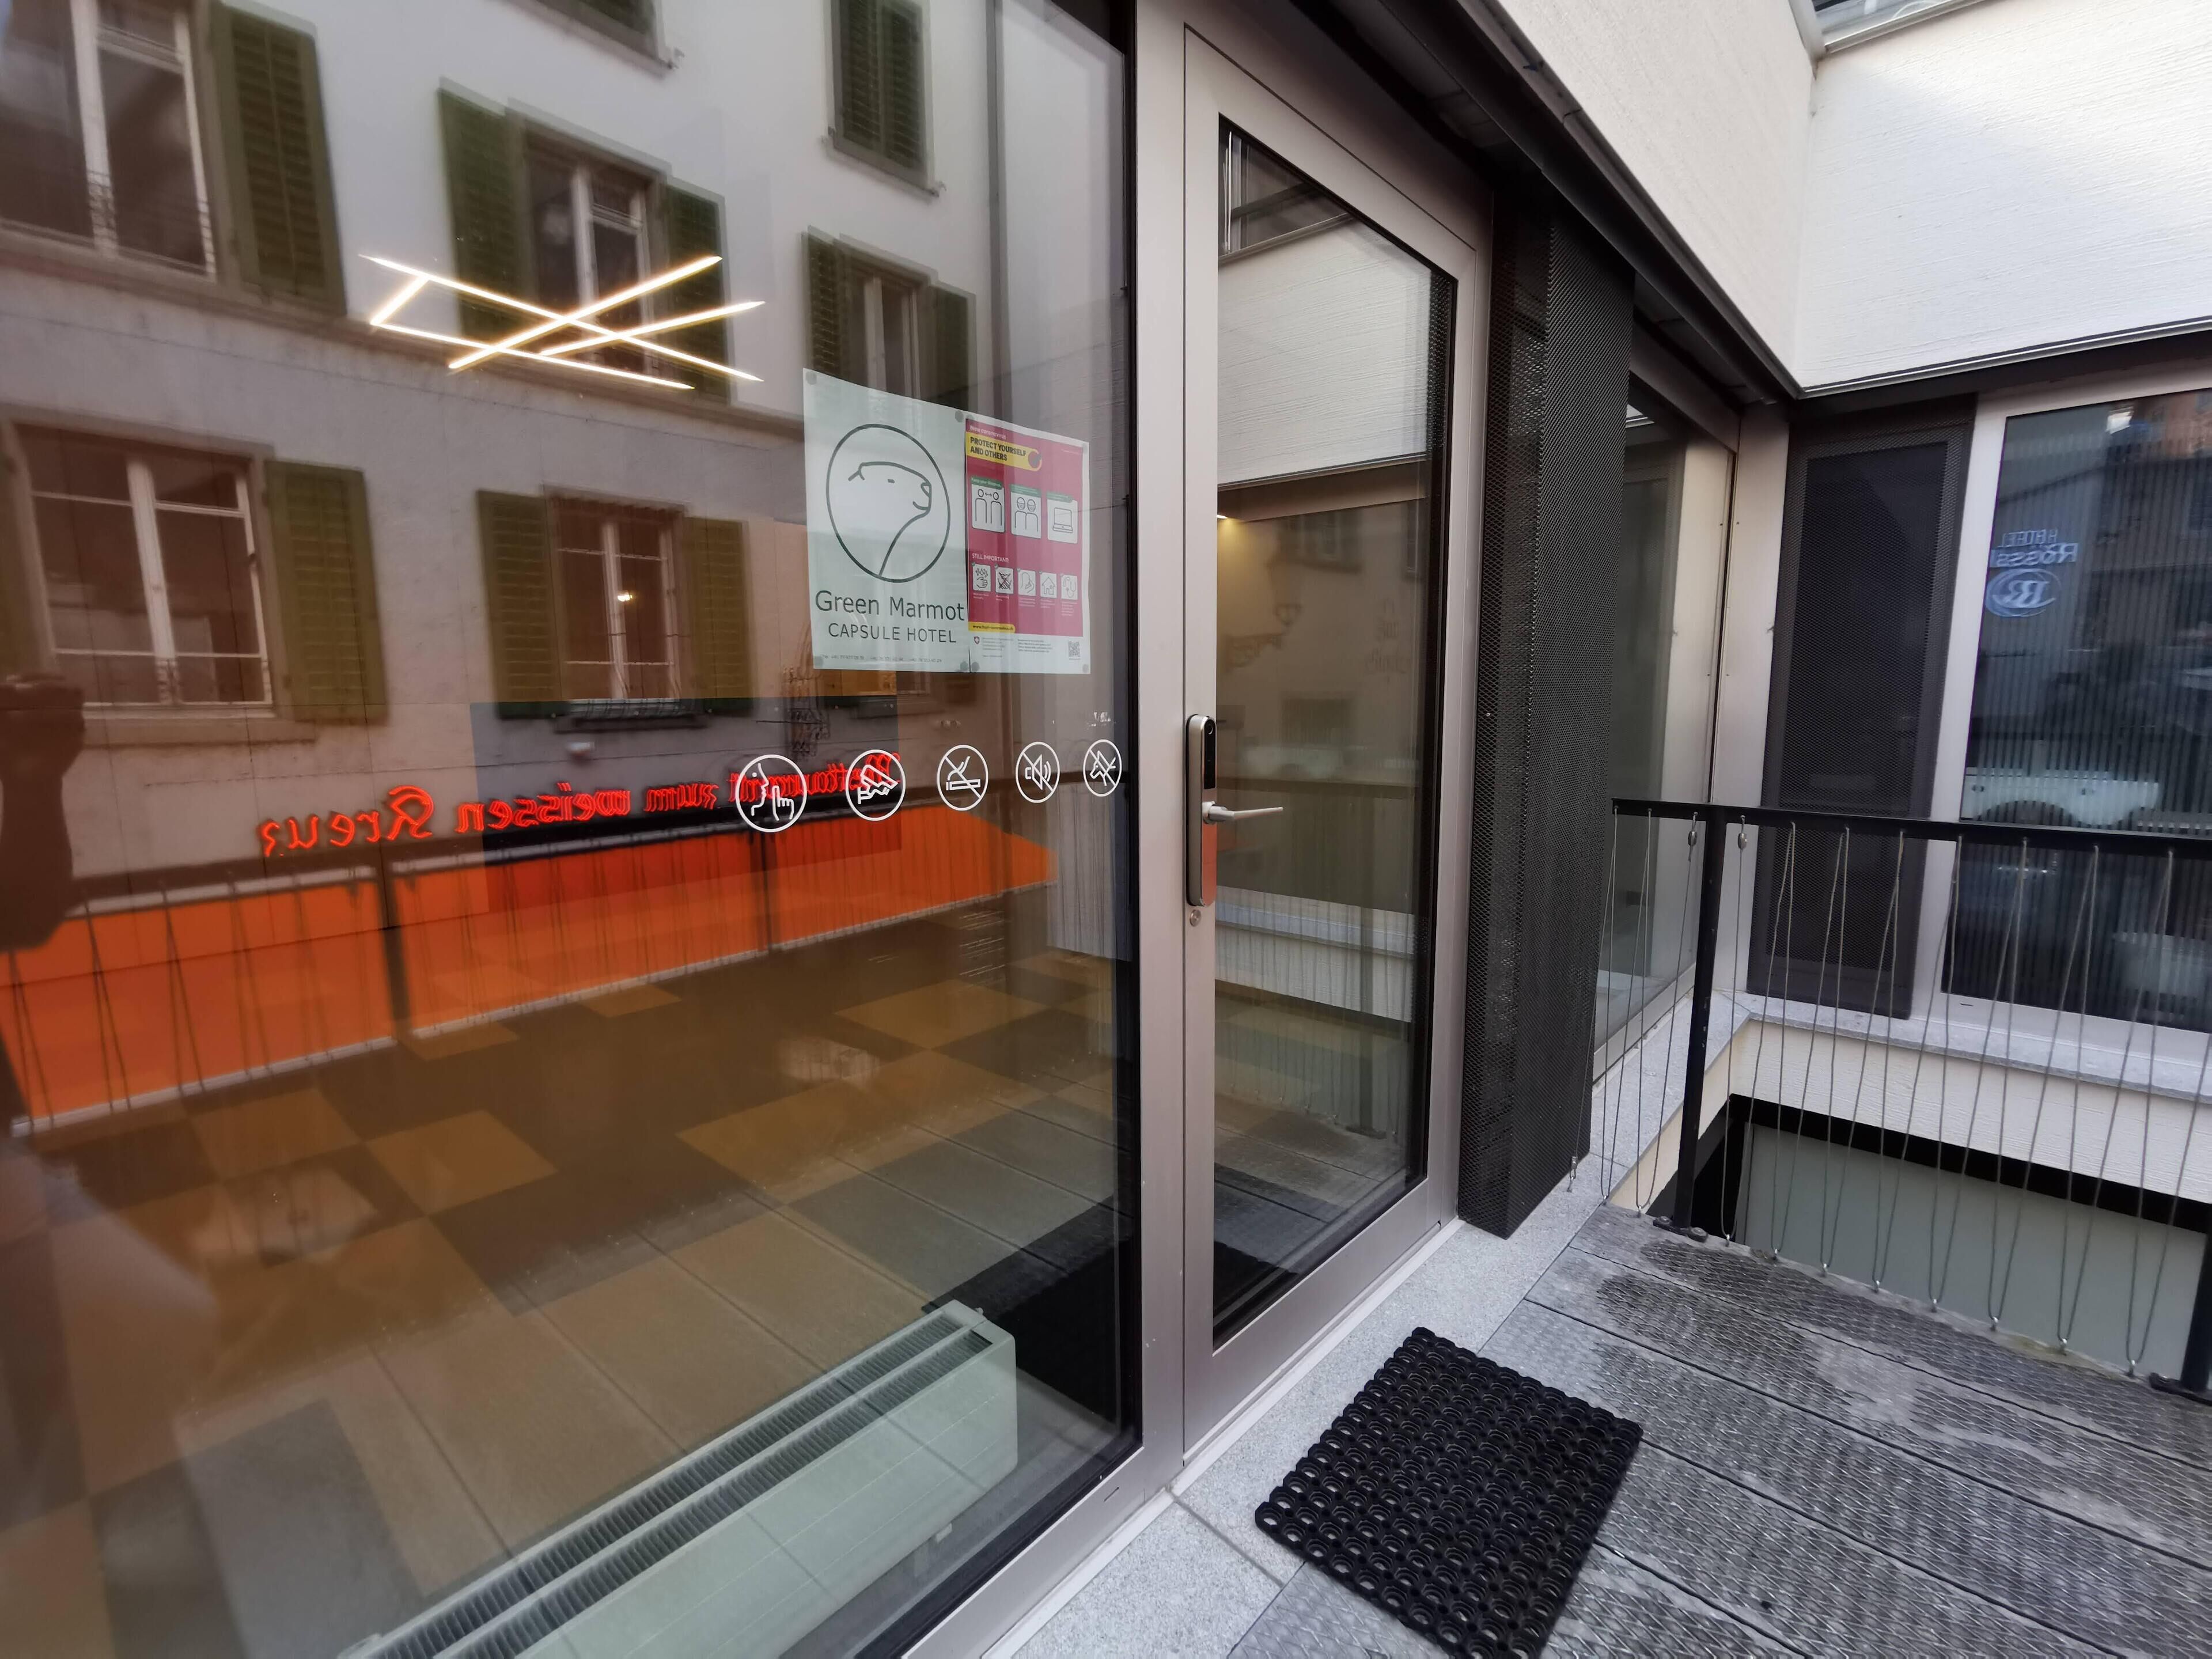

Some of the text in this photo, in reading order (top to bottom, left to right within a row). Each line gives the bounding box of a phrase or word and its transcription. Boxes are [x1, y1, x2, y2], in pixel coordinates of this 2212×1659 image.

[970, 437, 1027, 457] PROTECT YOURSELF
[970, 446, 1007, 461] AND OTHERS
[983, 555, 1009, 563] IMPORTANT:
[815, 589, 965, 621] Green Marmot
[828, 623, 957, 643] CAPSULE HOTEL
